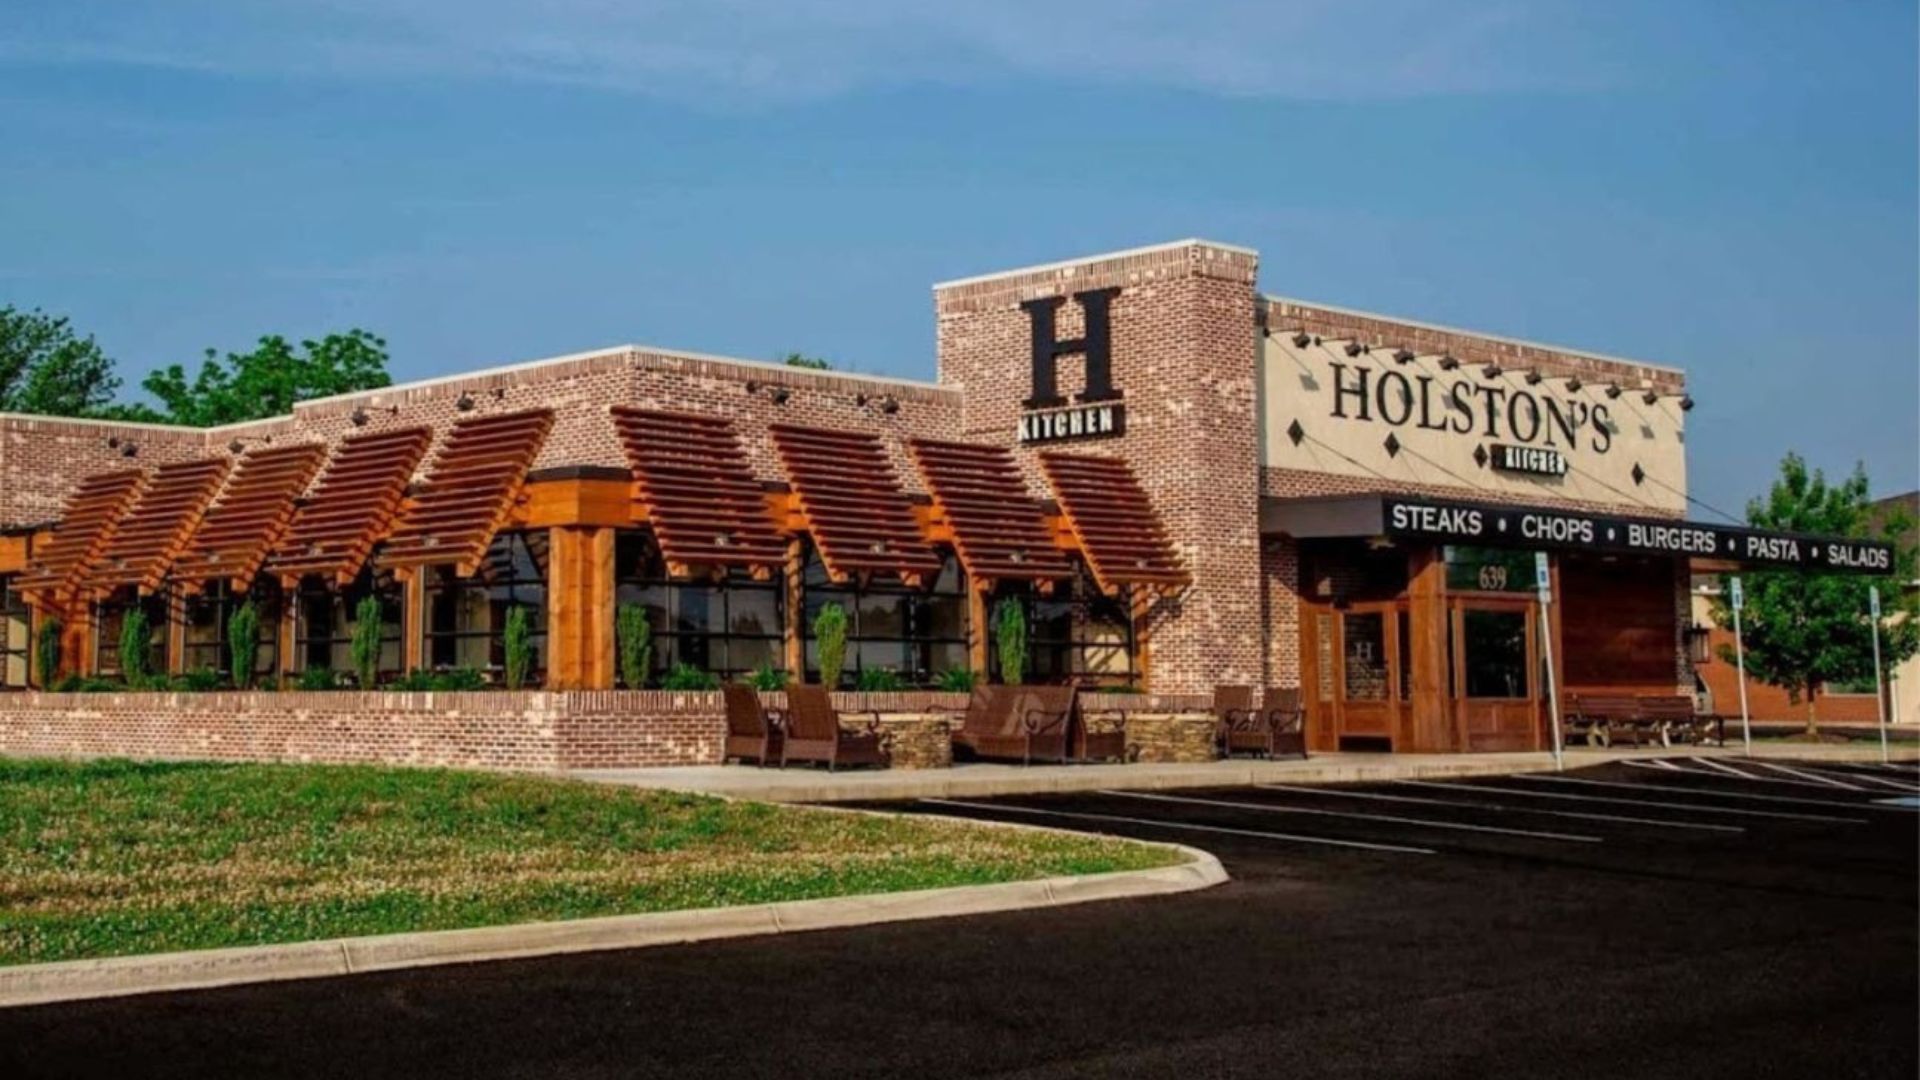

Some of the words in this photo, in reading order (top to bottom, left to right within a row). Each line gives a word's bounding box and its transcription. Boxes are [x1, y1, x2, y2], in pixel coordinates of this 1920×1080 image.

[1020, 286, 1123, 409] H
[1018, 406, 1113, 440] KITCHEN
[1328, 362, 1611, 454] HOLSTON'S
[1505, 446, 1566, 474] KITCHEN
[1392, 504, 1483, 535] STEAKS
[1521, 515, 1594, 543] CHOPS
[1628, 524, 1716, 552] BURGERS
[1747, 536, 1800, 561] PASTA
[1828, 544, 1889, 569] SALADS
[1479, 565, 1506, 589] 639
